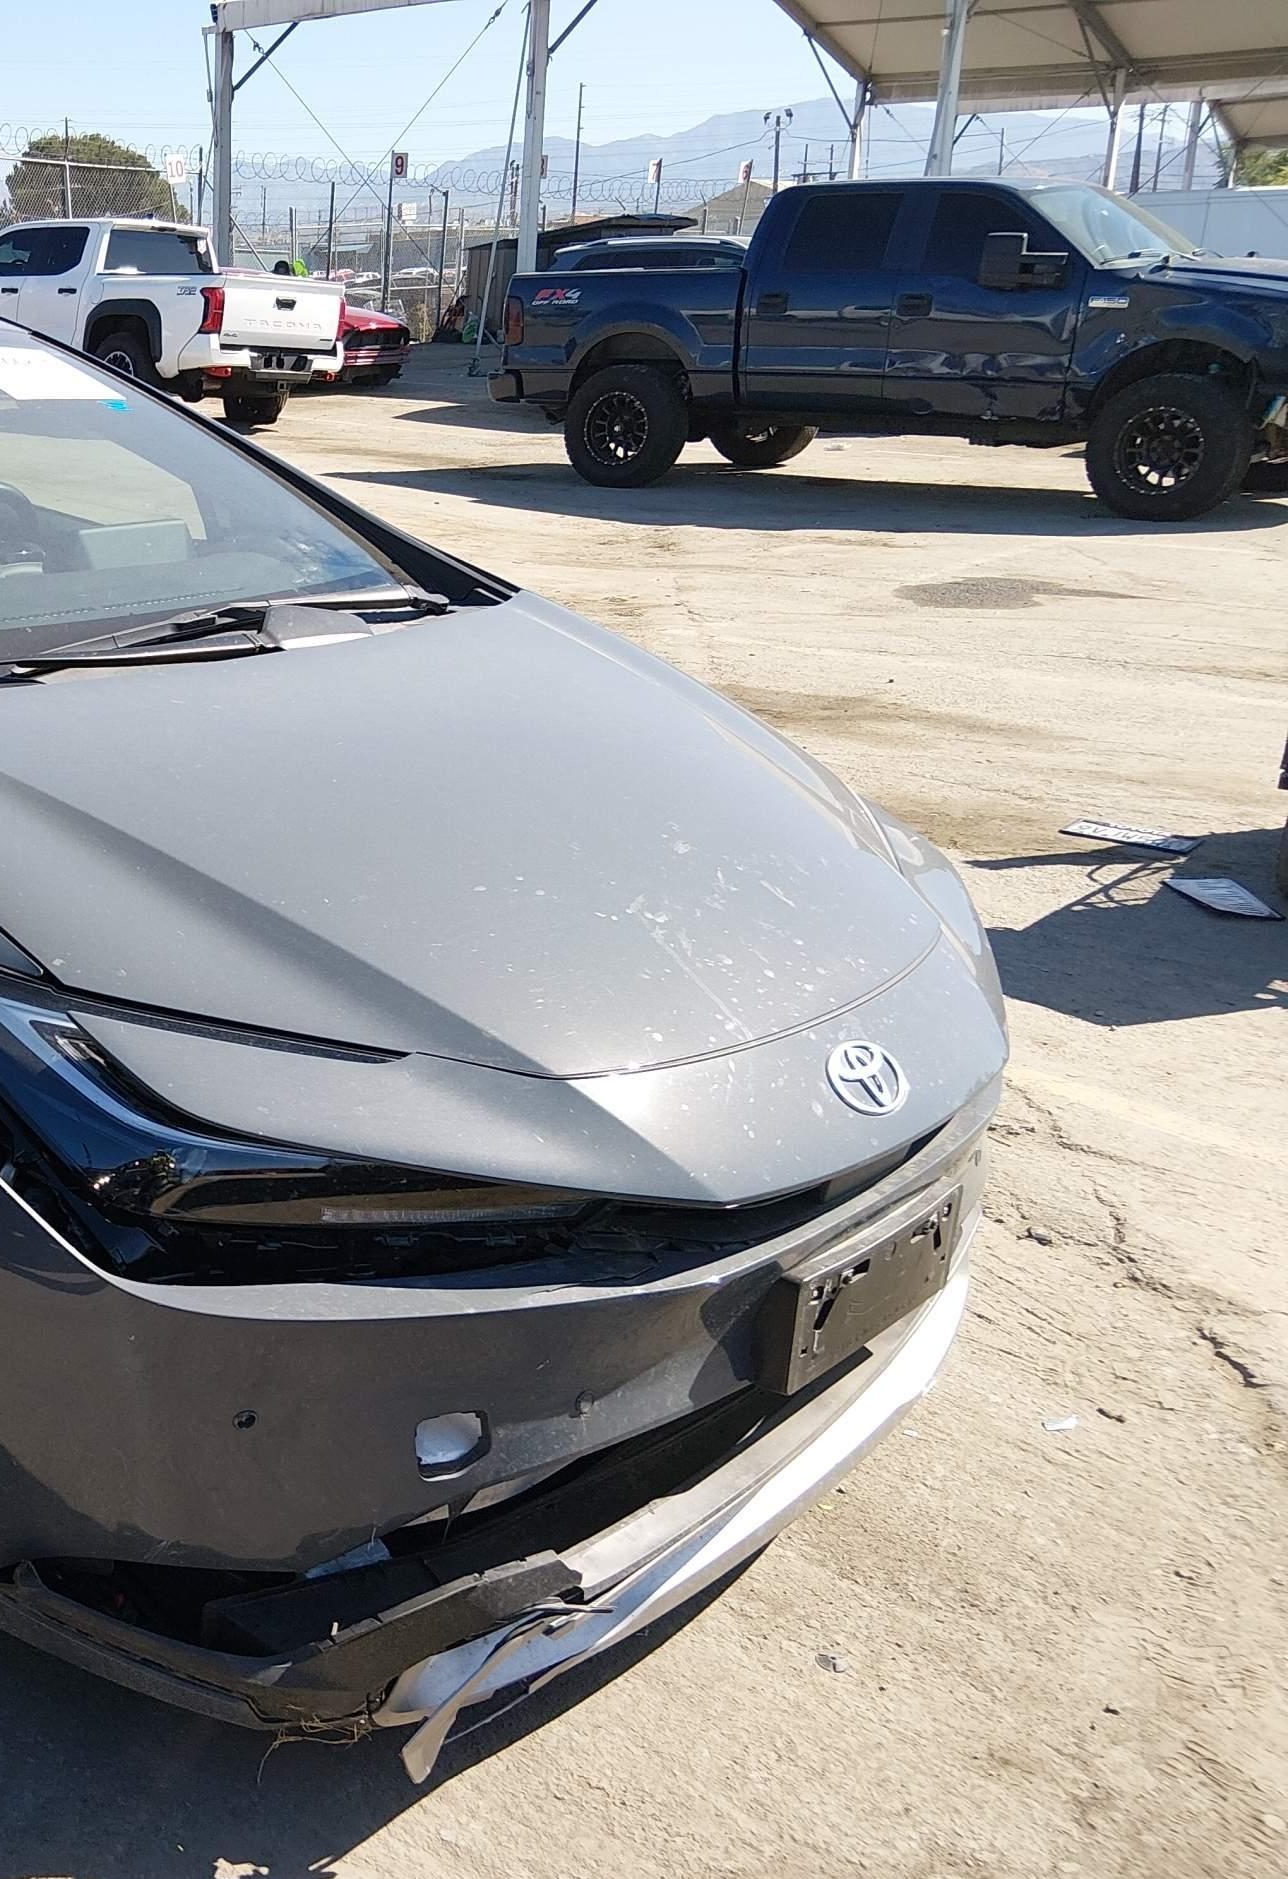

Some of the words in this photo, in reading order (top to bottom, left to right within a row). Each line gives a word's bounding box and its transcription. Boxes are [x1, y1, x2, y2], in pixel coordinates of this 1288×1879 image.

[168, 160, 184, 178] 10
[395, 156, 404, 175] 9
[534, 288, 582, 300] FX4
[243, 318, 323, 330] TACOMA
